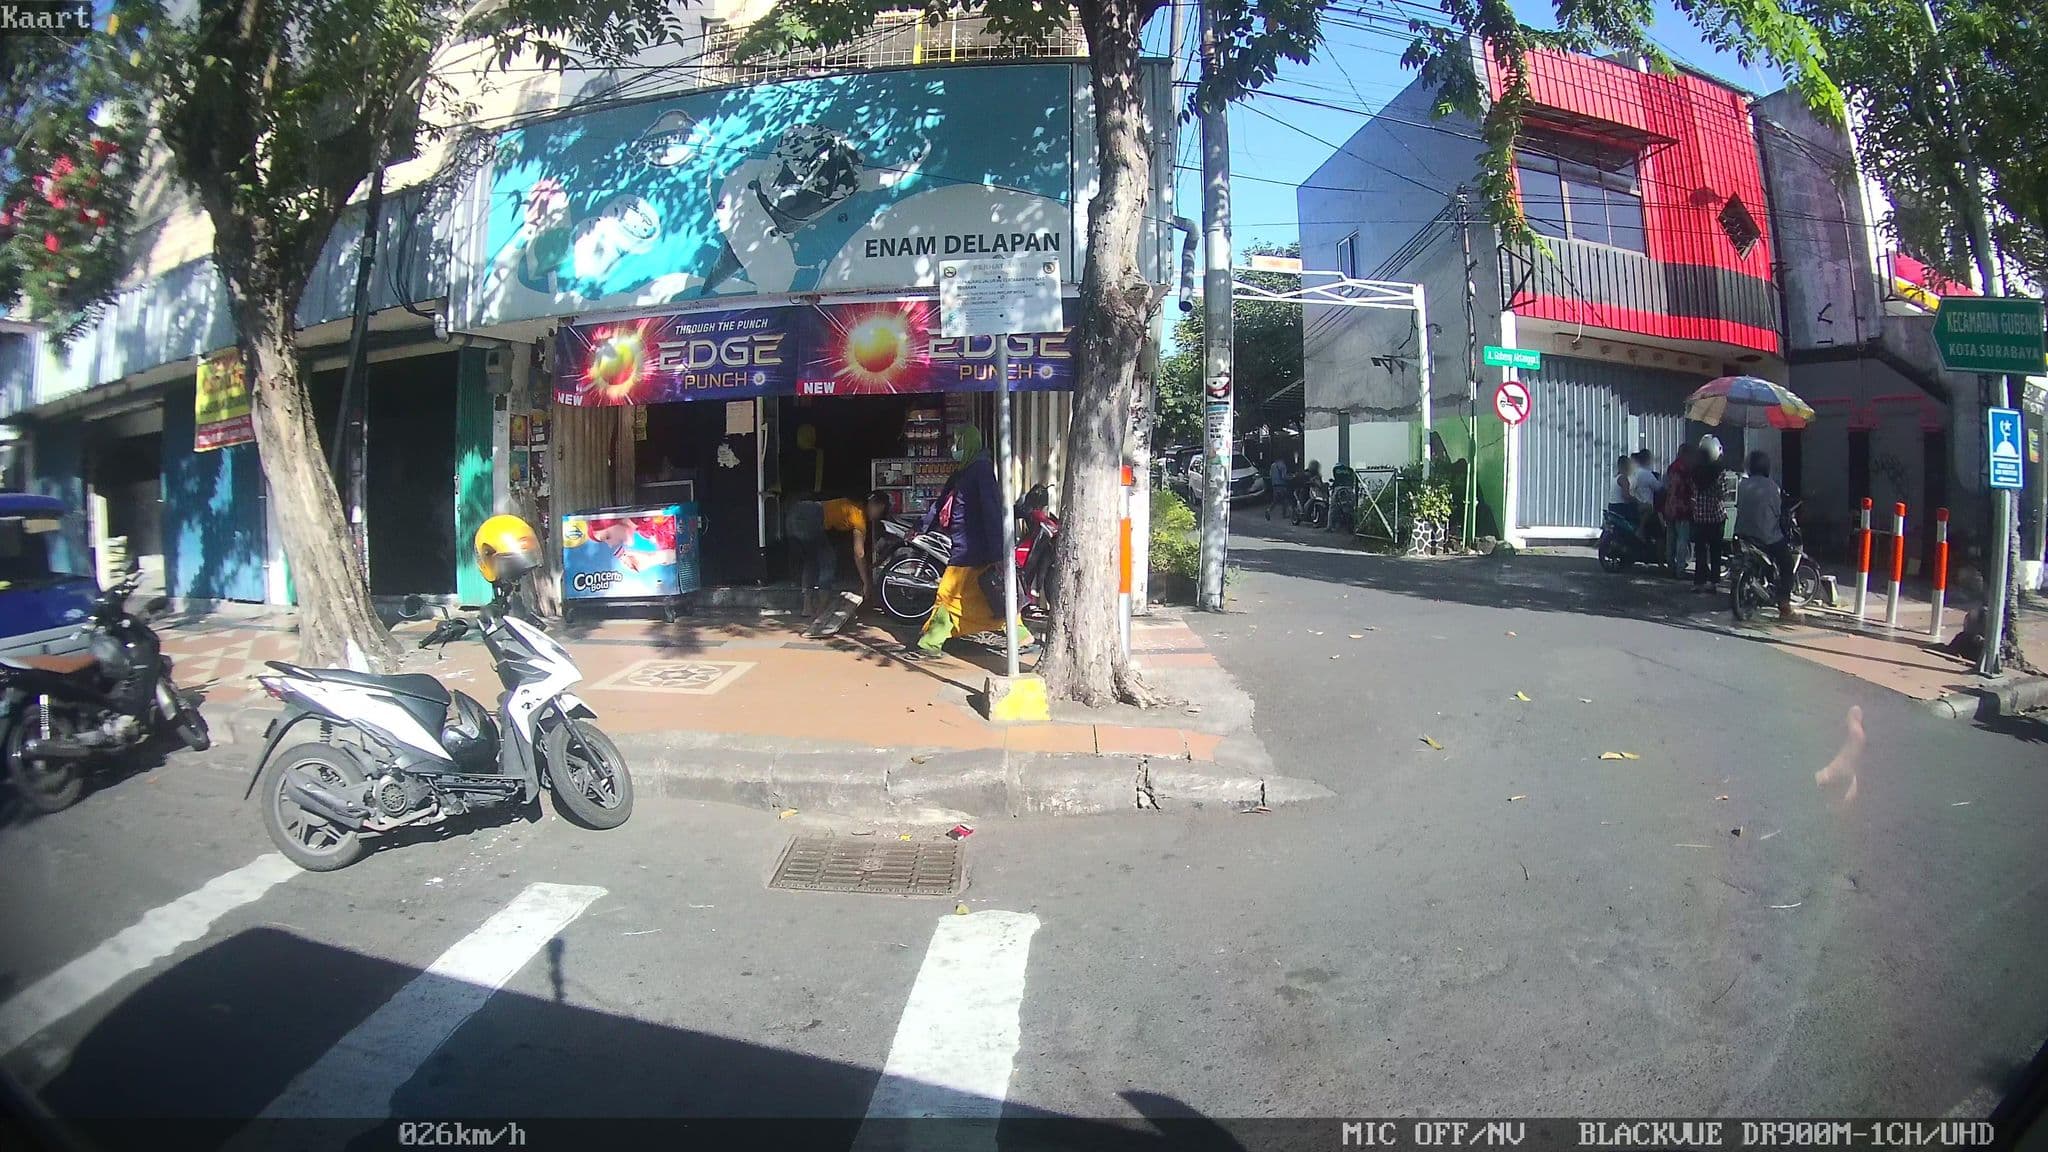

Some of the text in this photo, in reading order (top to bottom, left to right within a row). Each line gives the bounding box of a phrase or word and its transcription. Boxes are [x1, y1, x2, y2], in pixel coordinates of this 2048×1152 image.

[865, 232, 1060, 258] ENAM DELAPAN
[676, 319, 768, 335] THROUGH THE PUNCH
[1946, 311, 2039, 336] KECAMATAN GUBENG
[657, 333, 785, 371] EDGE
[1949, 343, 2040, 359] KOTA SURABAYA
[684, 372, 747, 390] PUNCH
[804, 382, 835, 393] NEW
[557, 392, 583, 406] NEW
[573, 571, 623, 591] Concerto
[591, 582, 609, 592] Bold
